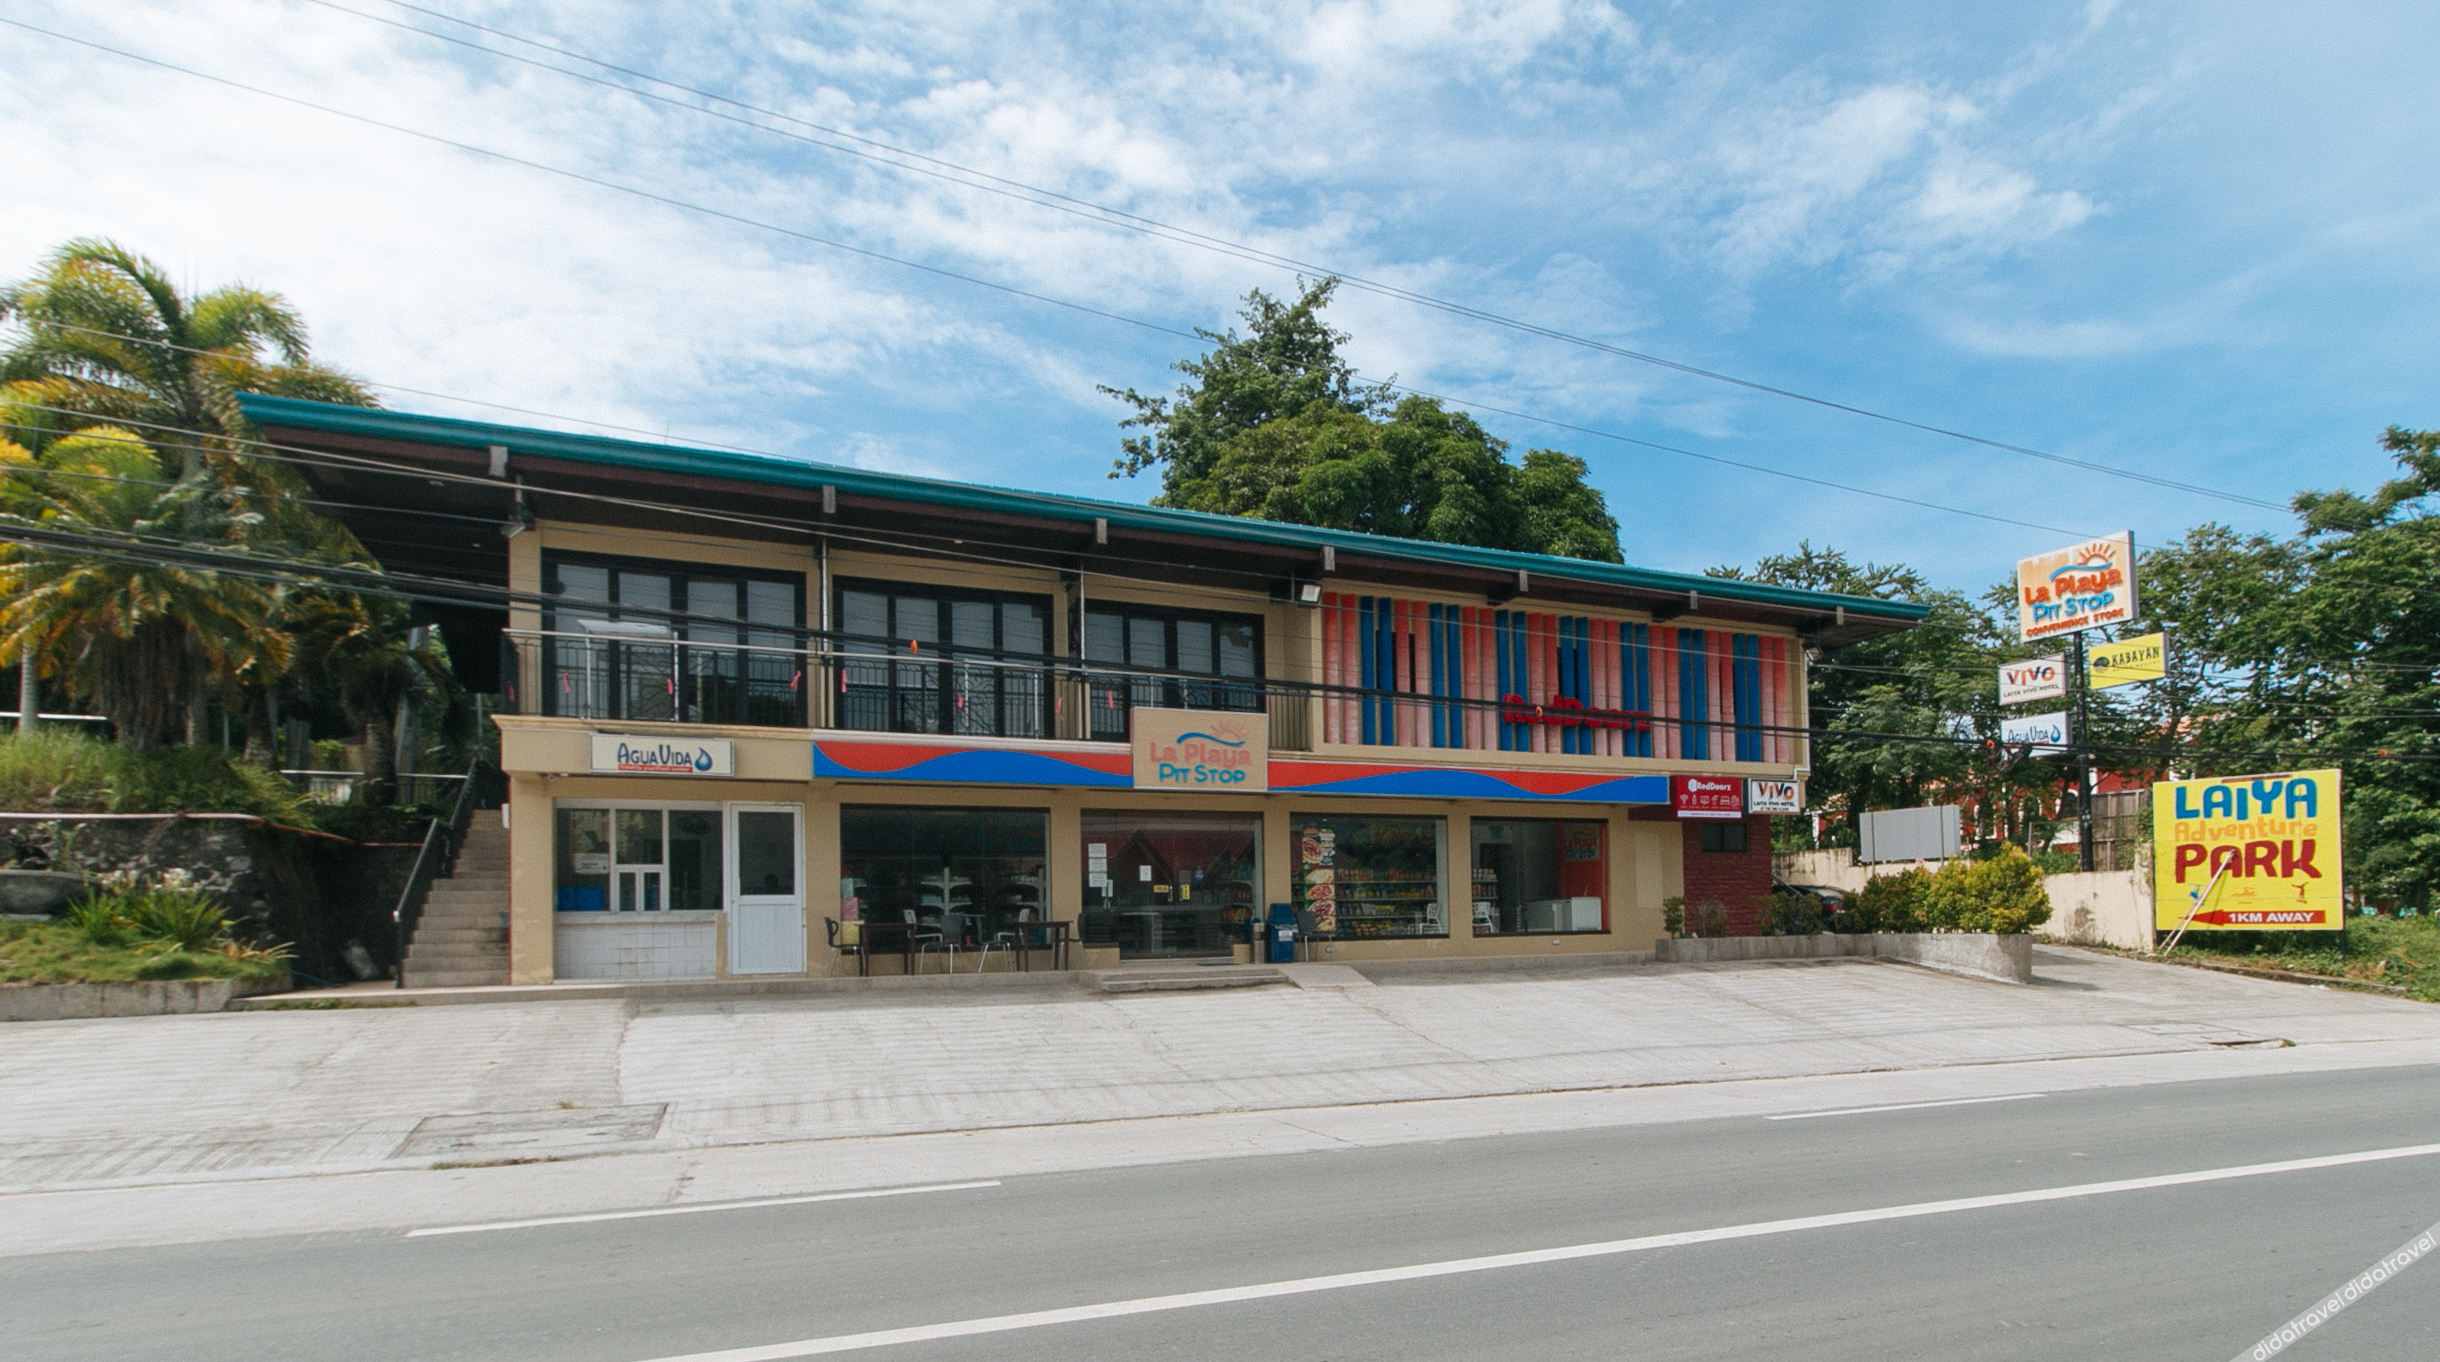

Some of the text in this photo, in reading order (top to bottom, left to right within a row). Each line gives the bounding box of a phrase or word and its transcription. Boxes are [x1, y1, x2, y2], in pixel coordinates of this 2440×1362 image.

[2024, 568, 2123, 605] La Playa
[2026, 607, 2124, 637] CONVENIENCE STORE
[2111, 646, 2160, 668] KABAYAN
[2007, 666, 2055, 686] VIVO
[2023, 687, 2038, 695] VIVO
[2039, 684, 2060, 692] HOTEL
[1150, 742, 1253, 769] La Playa
[1696, 781, 1732, 791] RedDoorz
[1758, 782, 1795, 800] VIVO
[2175, 777, 2318, 821] LAIYA
[2174, 816, 2319, 843] Adventure
[2175, 839, 2323, 884] PARK
[2228, 911, 2315, 924] 1KM AWAY
